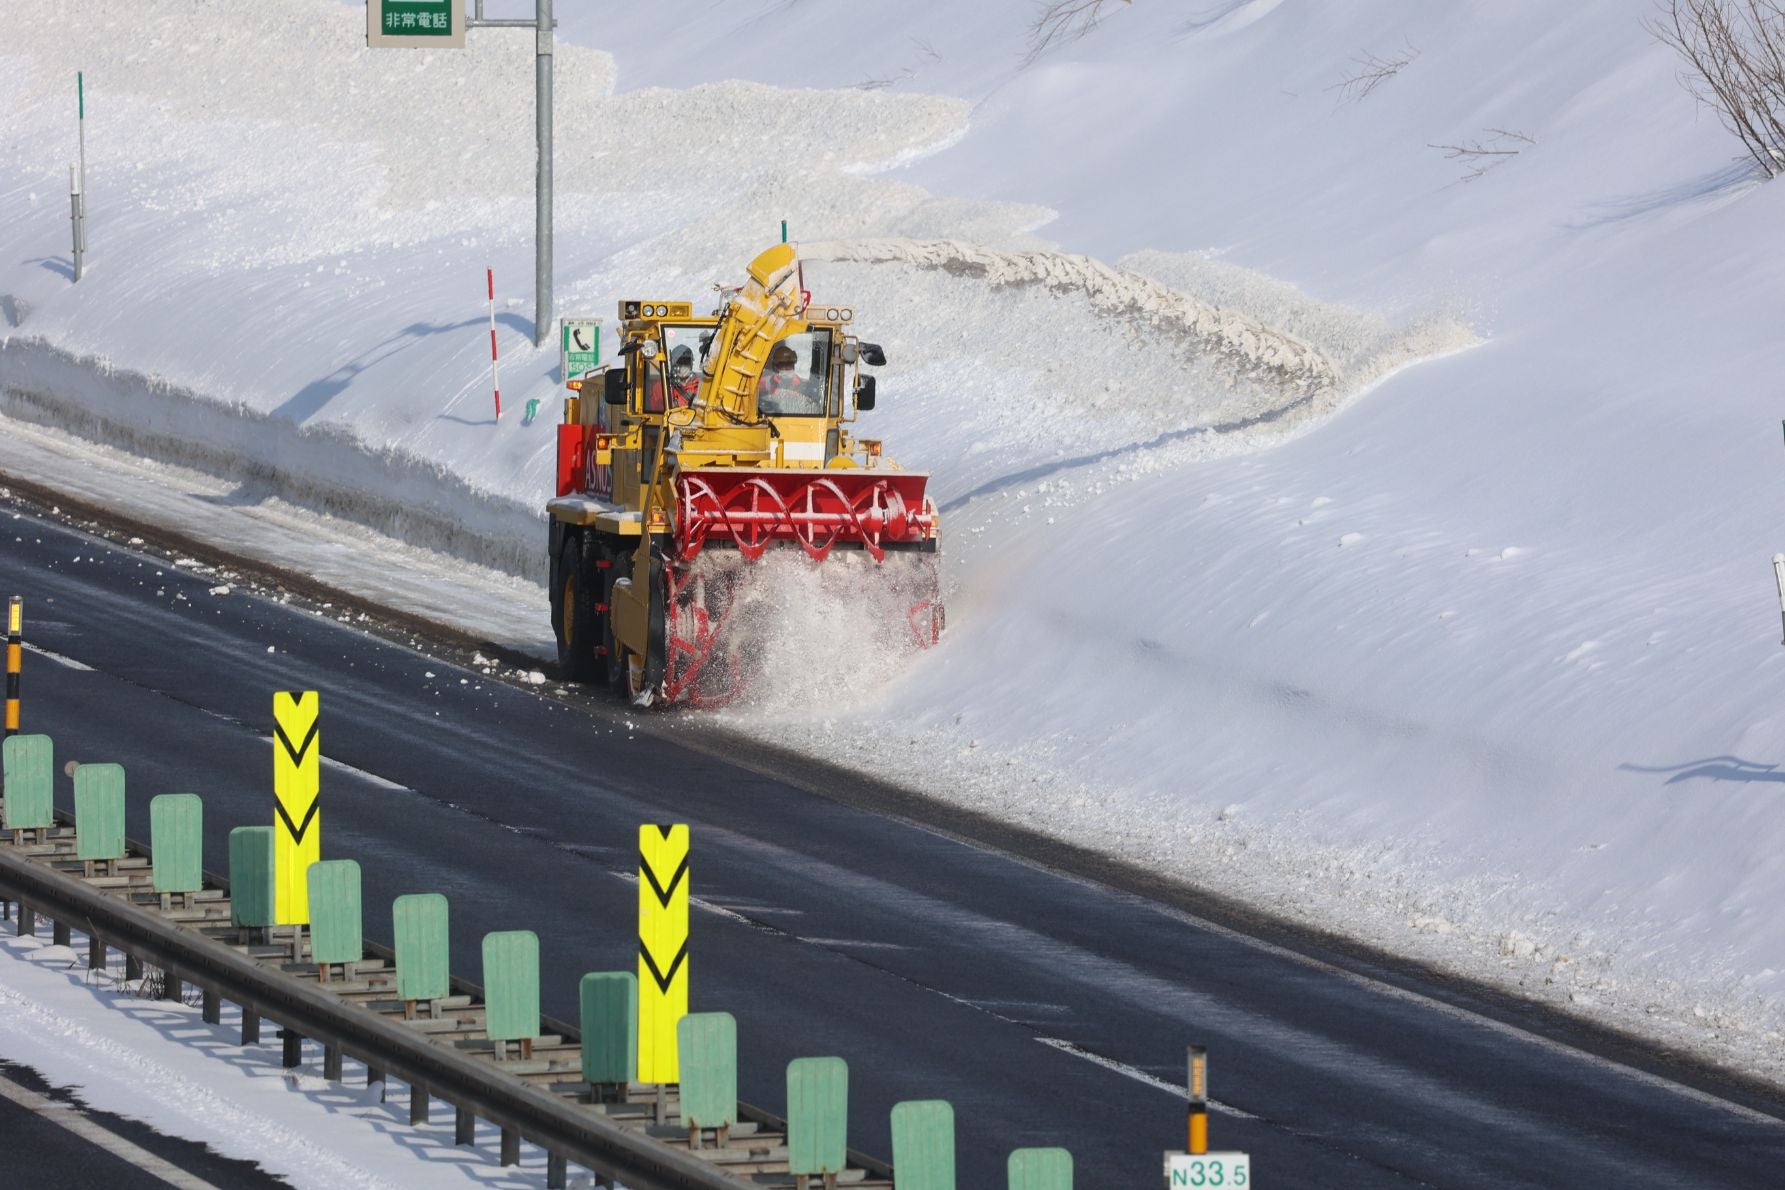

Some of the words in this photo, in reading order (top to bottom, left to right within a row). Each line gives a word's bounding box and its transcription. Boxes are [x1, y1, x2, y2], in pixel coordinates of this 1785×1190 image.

[386, 12, 447, 28] 非常電話
[1173, 1161, 1247, 1187] N33.5
